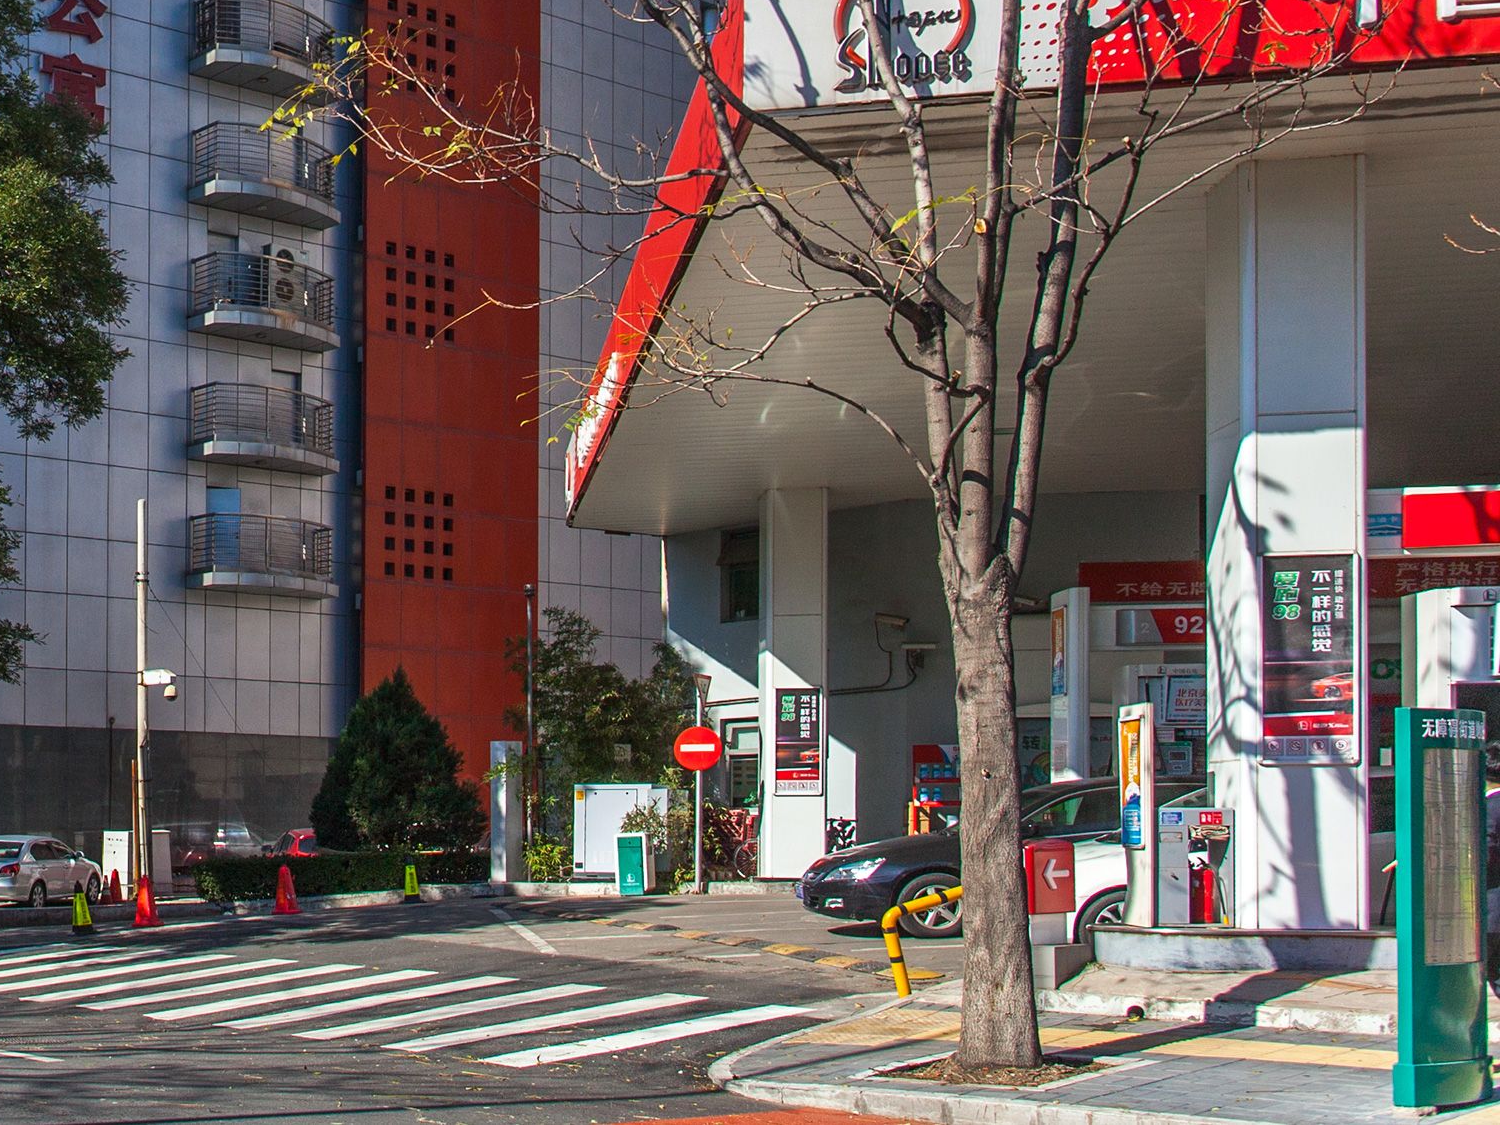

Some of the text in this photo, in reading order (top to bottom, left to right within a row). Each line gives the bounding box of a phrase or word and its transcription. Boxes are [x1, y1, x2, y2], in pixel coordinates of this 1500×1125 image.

[1311, 569, 1332, 652] 不一样的感觉
[1141, 622, 1150, 634] 2
[1174, 615, 1204, 635] 92
